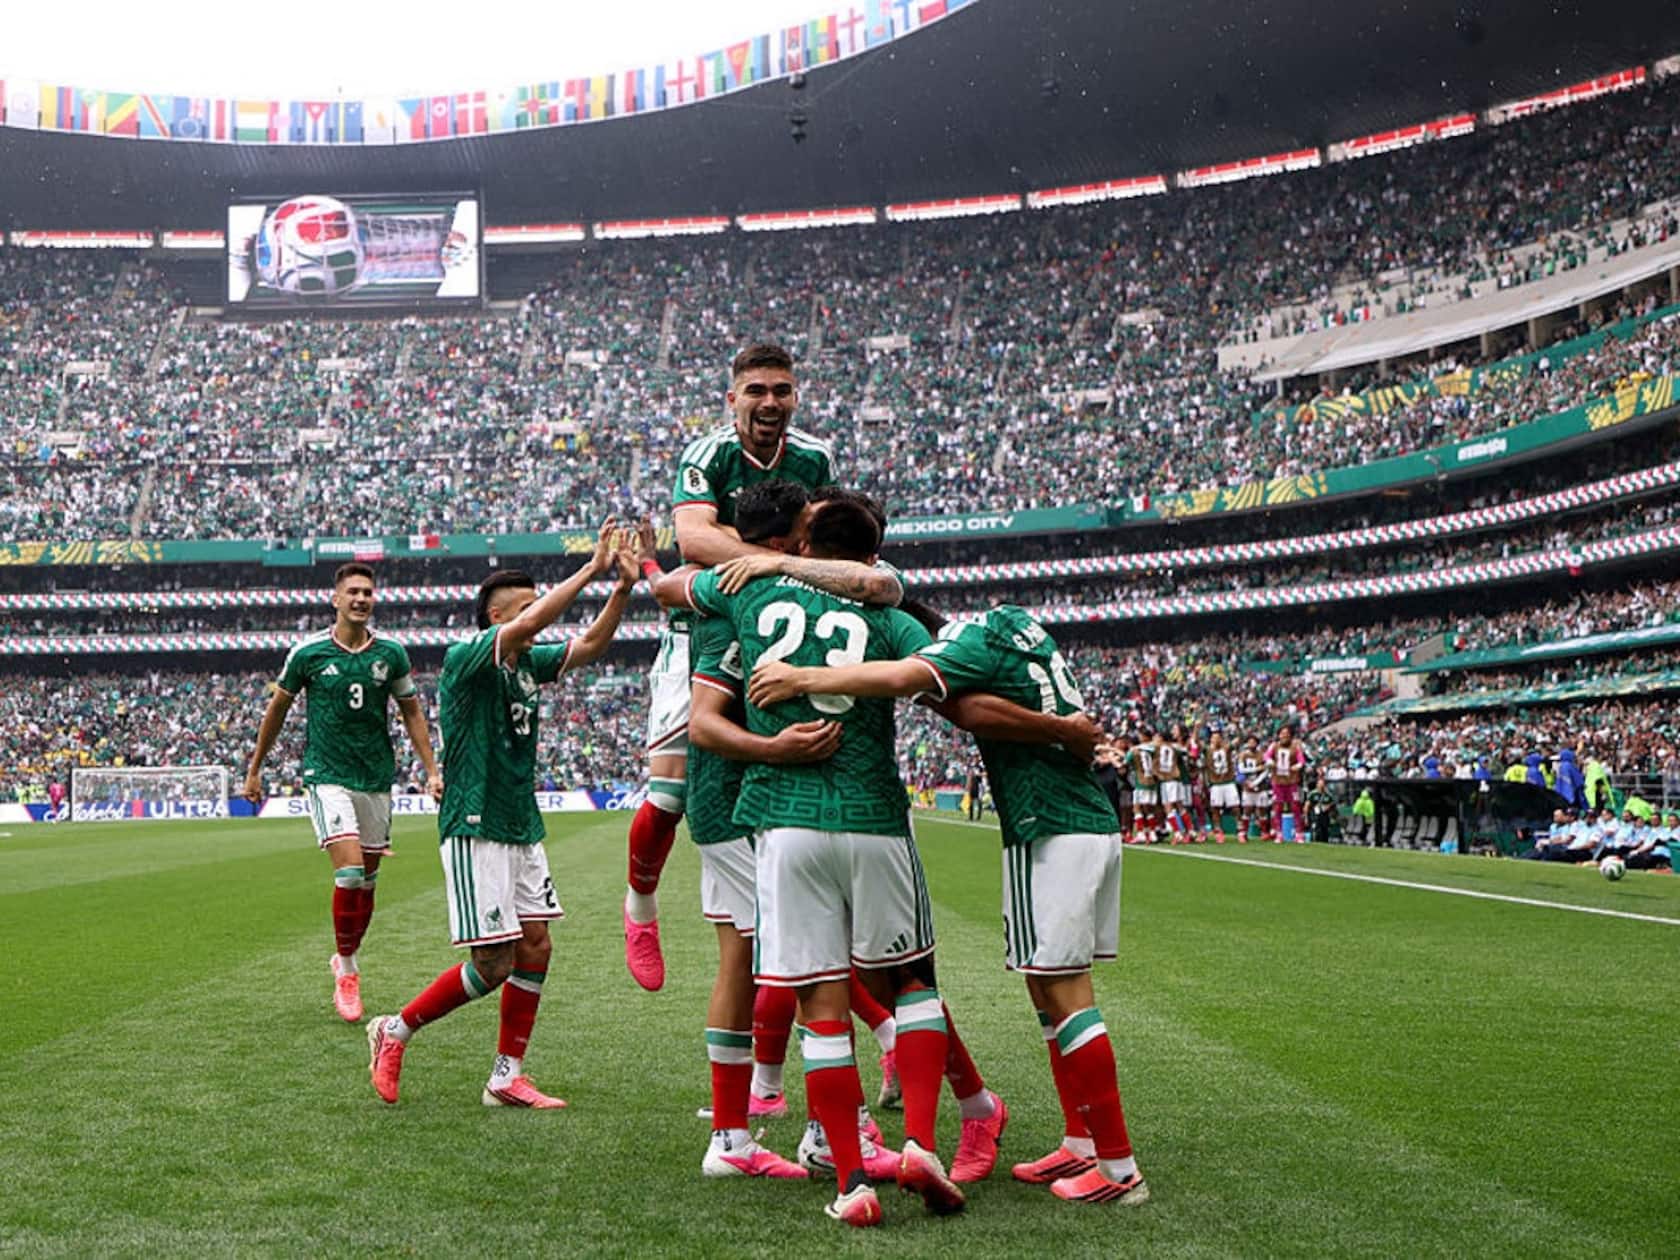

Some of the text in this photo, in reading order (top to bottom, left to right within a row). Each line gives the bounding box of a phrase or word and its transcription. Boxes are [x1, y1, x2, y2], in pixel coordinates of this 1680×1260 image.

[884, 515, 1015, 535] MEXICO CITY
[753, 600, 870, 714] 23
[349, 682, 364, 710] 3
[150, 799, 226, 818] ULTRA
